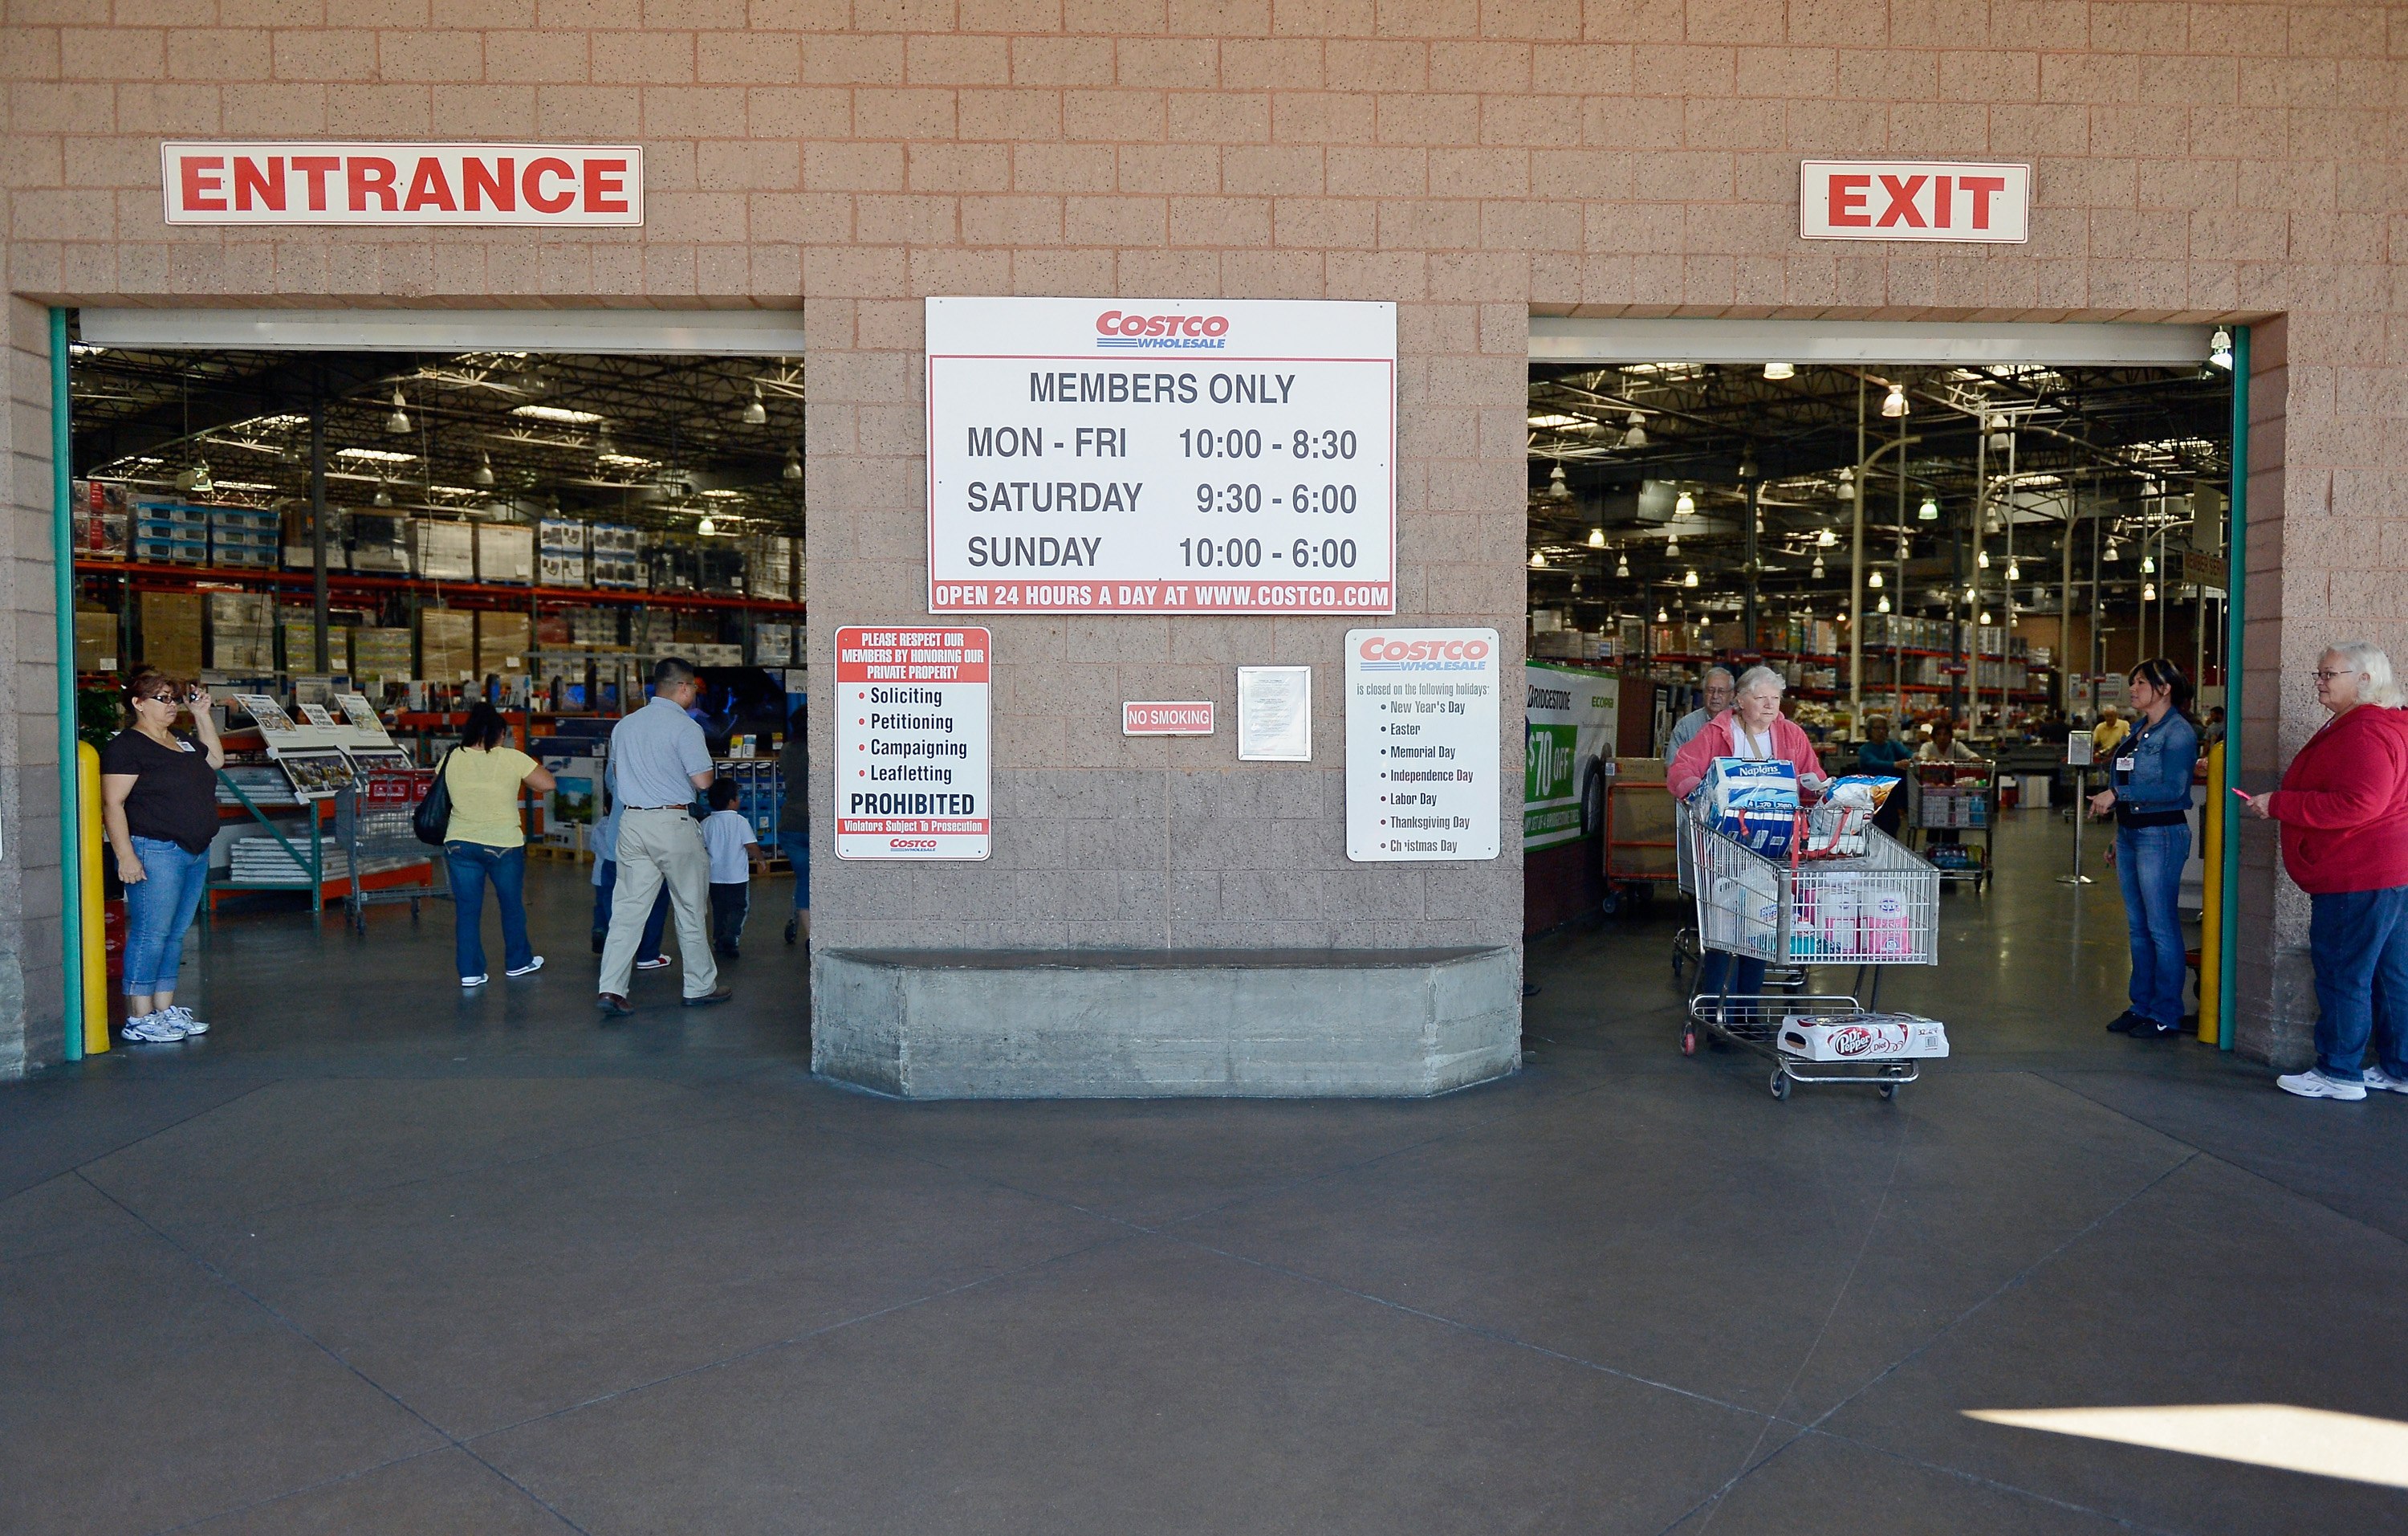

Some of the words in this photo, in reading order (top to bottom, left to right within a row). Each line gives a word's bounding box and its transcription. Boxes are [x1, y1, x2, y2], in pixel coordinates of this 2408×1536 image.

[180, 156, 628, 214] ENTRANCE
[1828, 174, 2005, 230] EXIT
[1096, 310, 1229, 336] COSTCO
[1137, 338, 1226, 348] WHOLESALE
[1030, 372, 1198, 403] MEMBERS
[1209, 373, 1296, 404] ONLY
[967, 426, 1043, 458] MON
[1076, 427, 1127, 458] FRI
[1179, 429, 1262, 459] 10:00
[1292, 430, 1357, 460] 8:30
[967, 481, 1144, 513] SATURDAY
[1196, 483, 1262, 514] 9:30
[1292, 483, 1357, 515] 6:00
[967, 536, 1102, 568] SUNDAY
[1179, 537, 1262, 568] 10:00
[1292, 538, 1357, 568] 6:00
[935, 585, 988, 605] OPEN
[995, 585, 1019, 605] 24
[1025, 585, 1092, 605] HOURS
[1098, 585, 1112, 605] A
[1118, 585, 1157, 605] DAY
[1164, 585, 1189, 605] AT
[1194, 585, 1389, 606] WWW.COSTCO.COM
[861, 633, 897, 646] PLEASE
[899, 633, 942, 647] RESPECT
[944, 633, 964, 646] OUR
[842, 649, 893, 663] MEMBERS
[895, 650, 908, 663] BY
[910, 650, 962, 663] HONORING
[964, 650, 984, 663] OUR
[1360, 637, 1489, 662] COSTCO
[867, 666, 907, 679] PRIVATE
[909, 666, 959, 679] PROPERTY
[1399, 661, 1487, 671] WHOLESALE
[870, 687, 942, 707] Soliciting
[1357, 683, 1365, 695] is
[1366, 683, 1391, 695] closed
[1393, 686, 1403, 695] on
[1405, 683, 1417, 695] the
[1418, 683, 1454, 696] following
[1455, 683, 1490, 696] holidays:
[1527, 684, 1572, 711] BRIDGESTONE
[1390, 701, 1413, 714] New
[1415, 701, 1446, 714] Year's
[1448, 701, 1466, 715] Day
[870, 713, 954, 733] Petitioning
[1129, 710, 1148, 725] NO
[1150, 710, 1210, 725] SMOKING
[1390, 723, 1421, 735] Easter
[870, 739, 967, 759] Campaigning
[1390, 746, 1436, 759] Memorial
[1438, 746, 1456, 760] Day
[1528, 731, 1552, 797] $70
[1554, 747, 1570, 781] OFF
[1739, 765, 1779, 776] Napkins
[870, 764, 953, 784] Leafletting
[1390, 769, 1454, 784] Independence
[1457, 770, 1474, 784] Day
[851, 792, 975, 815] PROHIBITED
[1390, 792, 1418, 805] Labor
[1420, 792, 1438, 807] Day
[844, 820, 883, 832] Violators
[885, 820, 917, 833] Subject
[919, 820, 929, 832] To
[931, 820, 982, 832] Prosecution
[1390, 816, 1450, 830] Thanksgiving
[1453, 816, 1470, 830] Day
[889, 838, 938, 848] COSTCO
[1441, 840, 1458, 854] Day
[1849, 1030, 1862, 1041] Dr
[1840, 1035, 1871, 1053] Pepper
[1873, 1042, 1887, 1052] Diet
